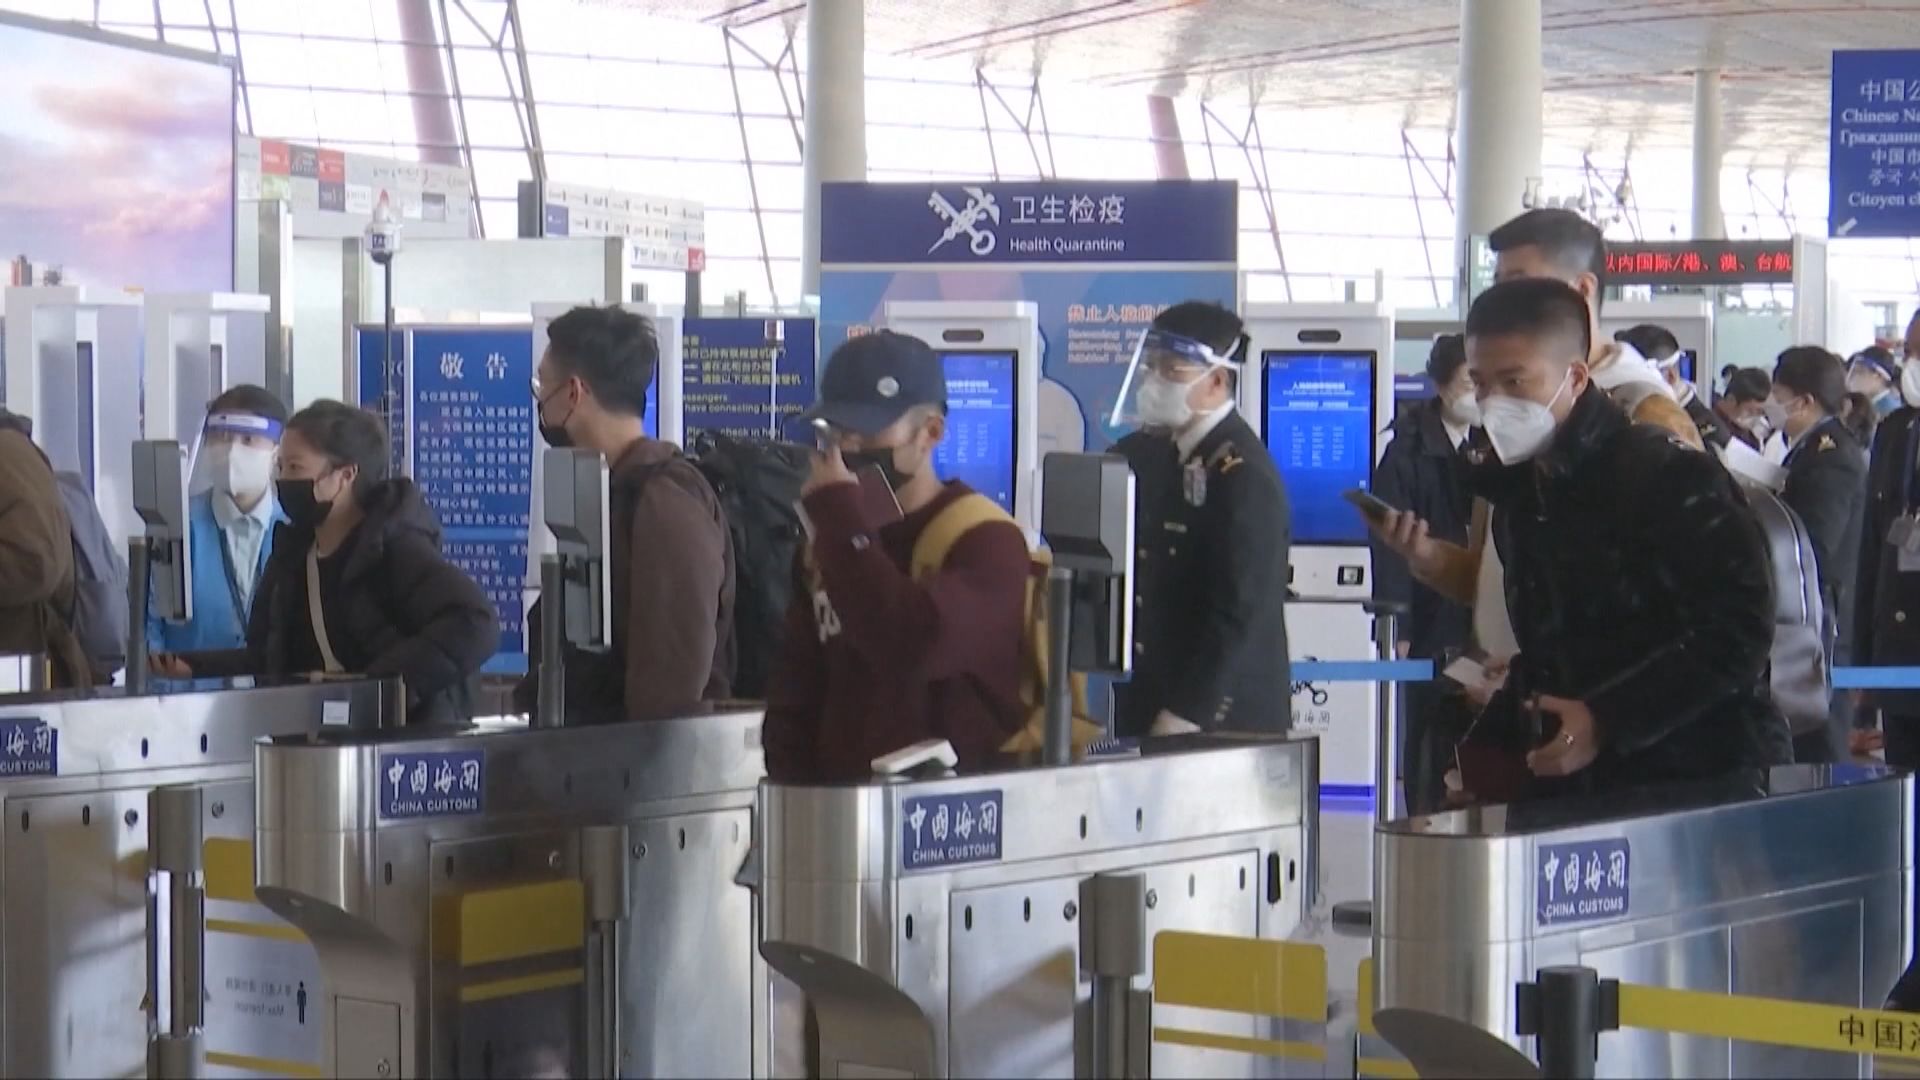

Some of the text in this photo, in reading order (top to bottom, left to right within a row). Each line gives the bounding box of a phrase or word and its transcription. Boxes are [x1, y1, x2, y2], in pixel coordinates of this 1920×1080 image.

[1842, 108, 1899, 123] Chinese
[1010, 194, 1126, 224] 卫生检疫
[1848, 191, 1905, 210] Citoyen
[1010, 236, 1125, 254] Health Quarantine
[390, 797, 478, 814] CHINA CUSTOMS
[912, 842, 997, 863] CHINA CUSTOMS
[1546, 896, 1623, 917] CHINA CUSTOMS
